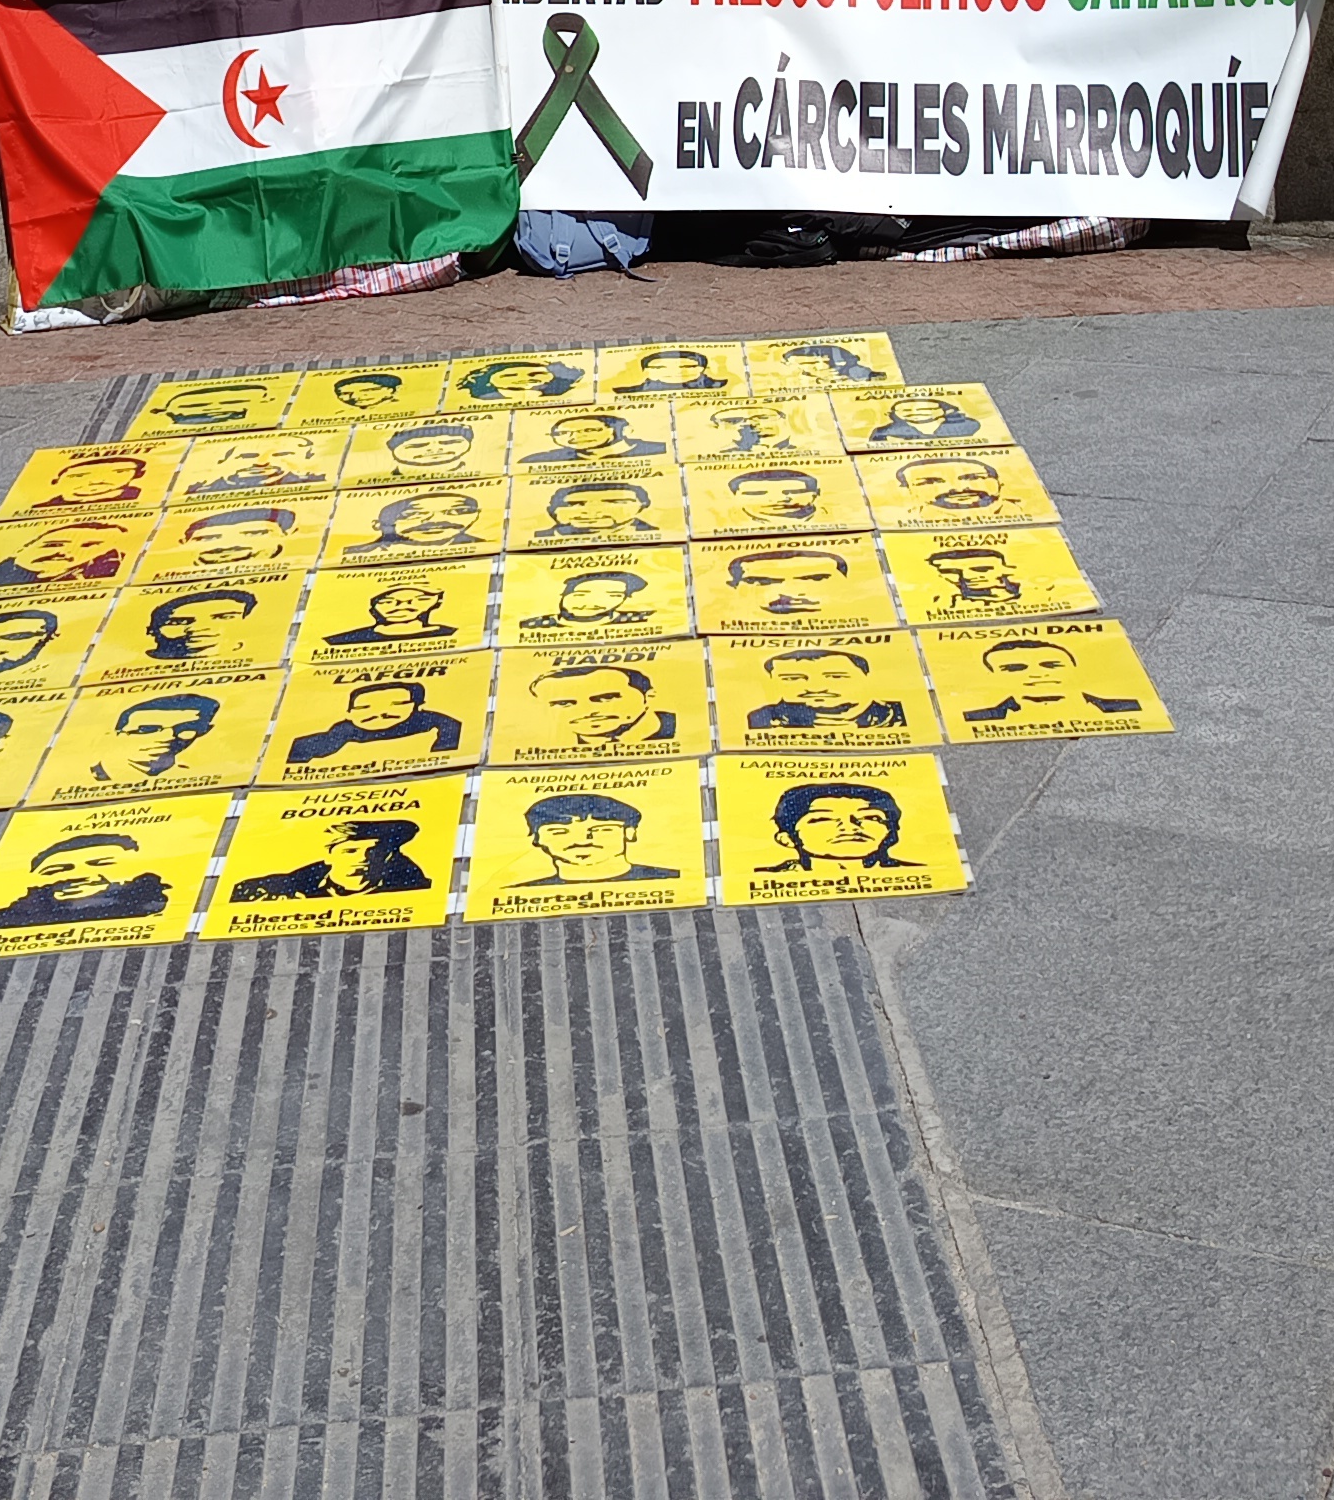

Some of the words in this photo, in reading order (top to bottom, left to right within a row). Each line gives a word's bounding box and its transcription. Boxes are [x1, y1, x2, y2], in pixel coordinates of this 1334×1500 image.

[678, 101, 720, 169] EN
[733, 51, 970, 176] CÁRCELES
[984, 55, 1276, 180] MARROQUÍE
[869, 453, 962, 463] MOHAMED
[346, 487, 419, 498] BRAHIM
[428, 480, 503, 492] ISMAILI
[701, 543, 772, 552] BRAHIM
[139, 585, 203, 596] SALEK
[206, 573, 289, 591] LAASIRI
[730, 637, 821, 648] HUSEIN
[828, 635, 891, 646] ZAUI
[938, 627, 1039, 641] HASSAN
[1046, 624, 1104, 635] DAH
[533, 649, 611, 659] MOHAMED
[552, 651, 656, 666] HADDI
[313, 666, 391, 677] MOHAMED
[393, 657, 469, 671] EMBAREK
[333, 665, 448, 684] LAFGIR
[96, 681, 184, 697] BACHIR
[188, 674, 266, 687] JADDA
[740, 760, 836, 771] LAAROUSSI
[839, 759, 907, 770] BRAHIM
[766, 769, 845, 779] ESSALEM
[848, 768, 889, 778] AILA
[506, 771, 579, 785] AABIDIN
[581, 767, 673, 781] MOHAMED
[534, 782, 588, 793] FADEL
[590, 779, 648, 790] ELBAR
[303, 788, 408, 806] HUSSEIN
[86, 806, 152, 821] AYMAN
[281, 799, 421, 820] BOURAKBA
[60, 814, 172, 833] AL-YATHRIBI
[749, 876, 851, 891] Libertad
[856, 872, 932, 885] Presos
[493, 892, 599, 907] Libertad
[603, 888, 675, 901] Presos
[749, 887, 830, 900] Políticos
[834, 882, 932, 894] Saharauis
[577, 898, 674, 909] Saharauis
[231, 910, 334, 926] Libertad
[339, 906, 414, 918] Presos
[80, 924, 156, 937] Presos
